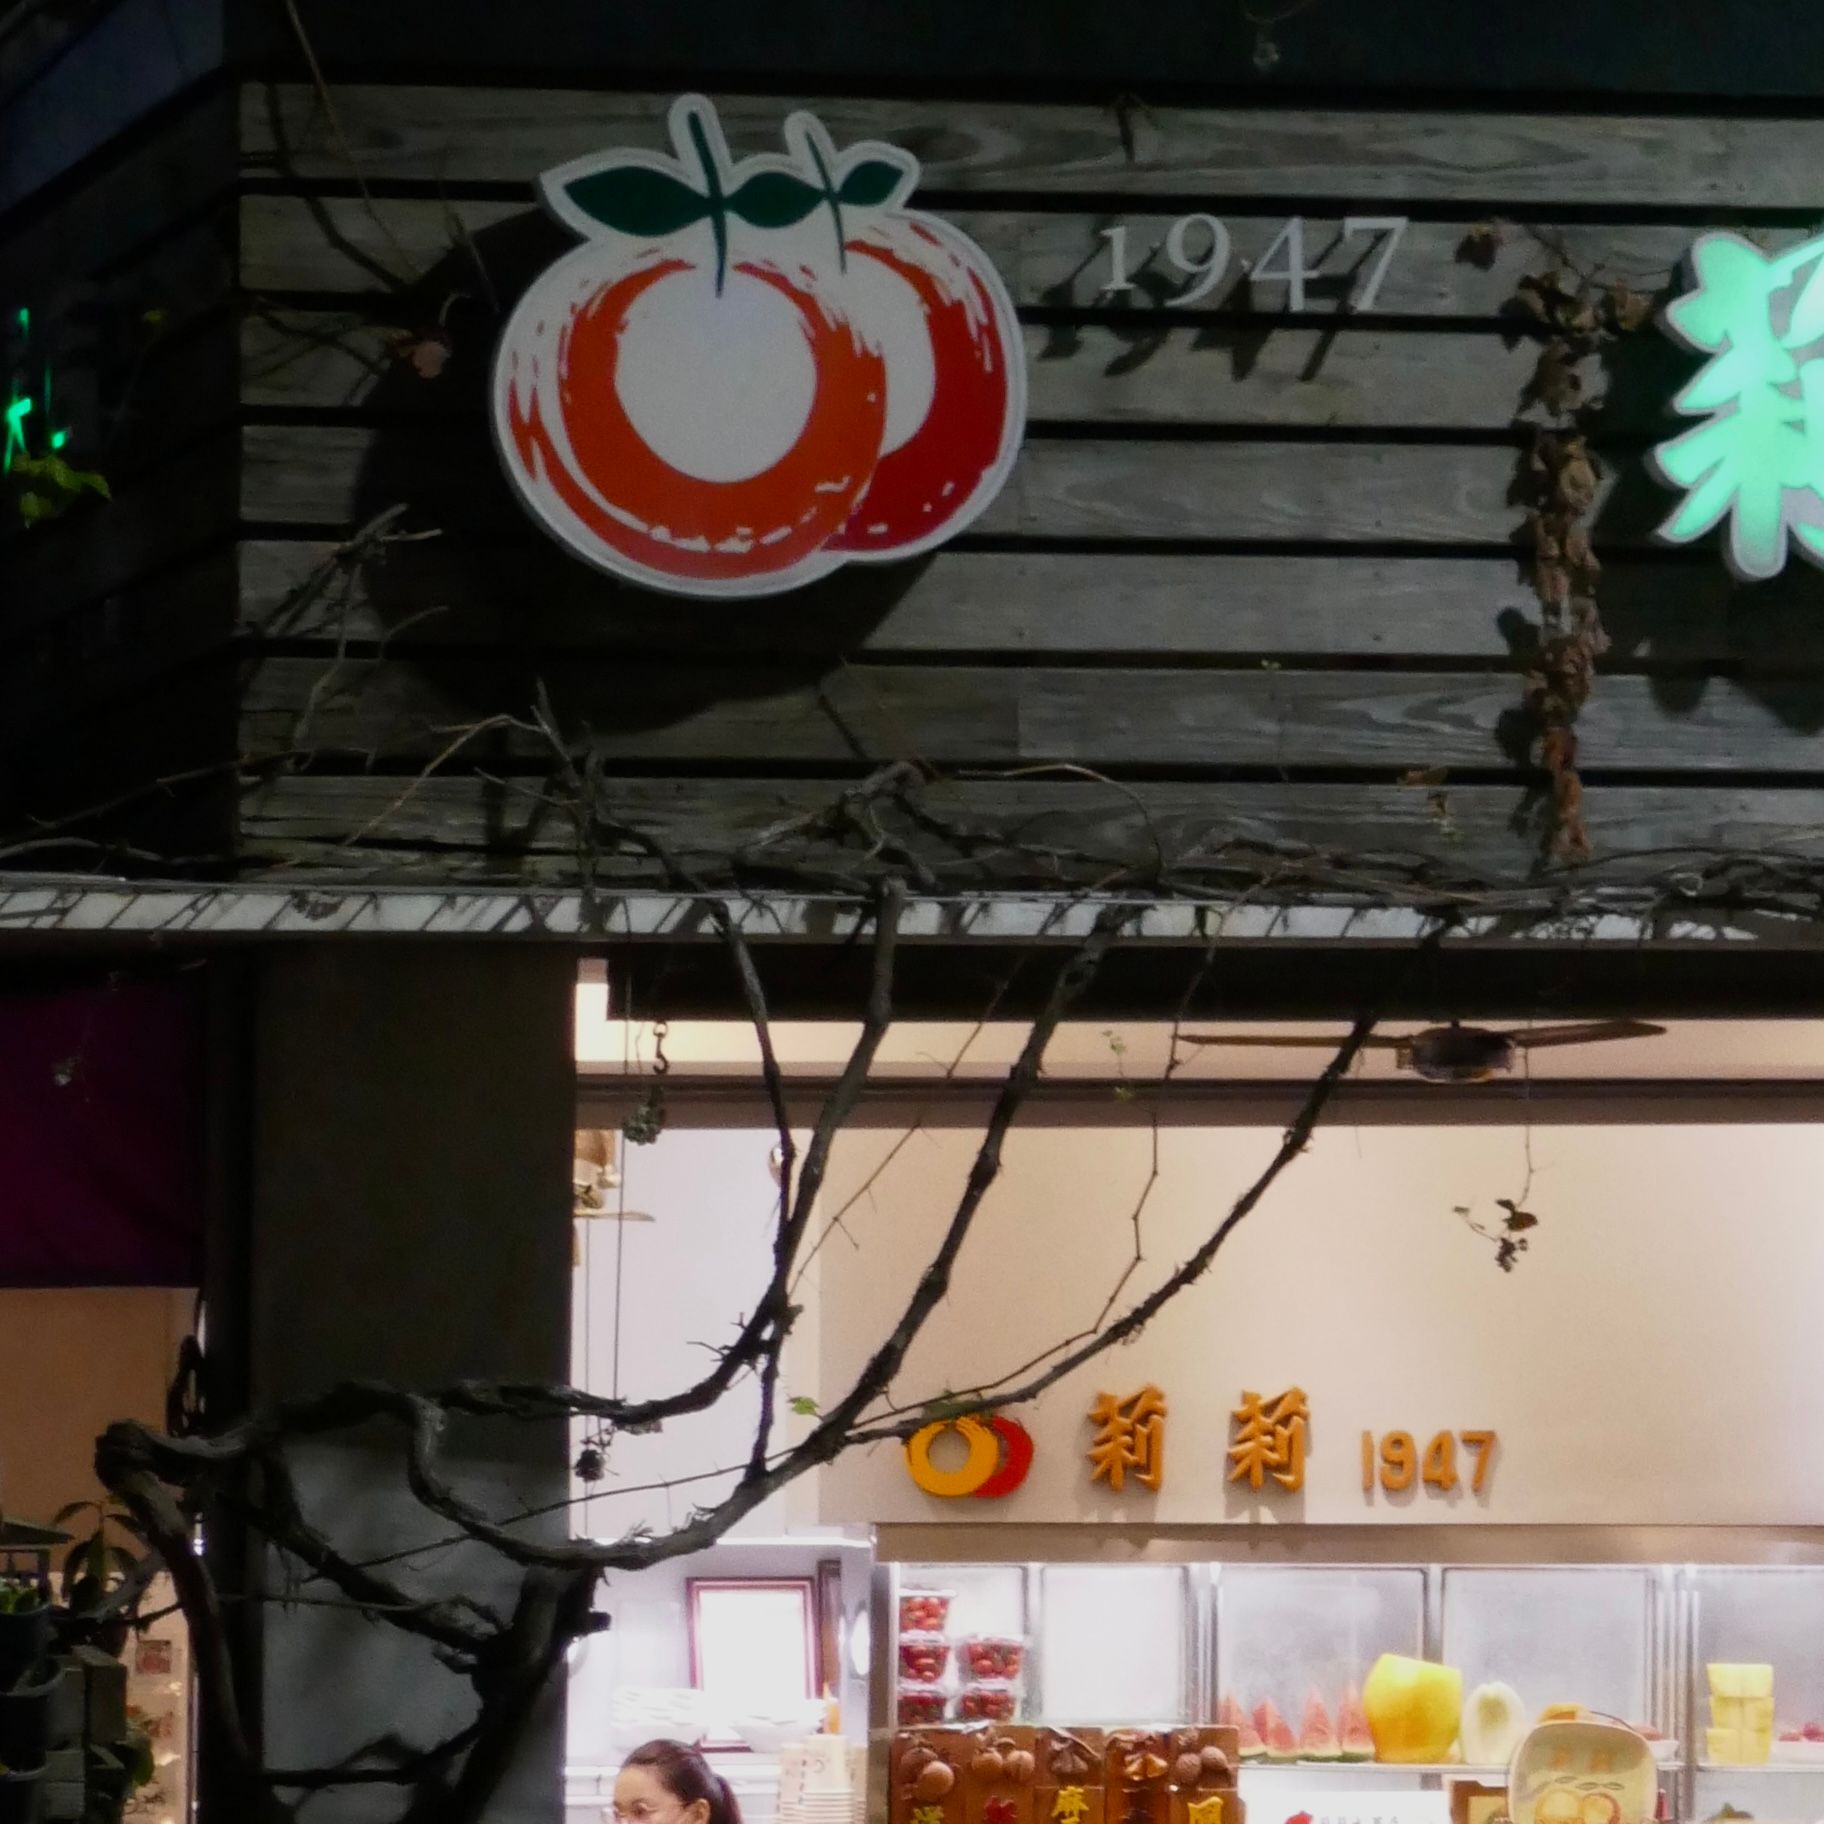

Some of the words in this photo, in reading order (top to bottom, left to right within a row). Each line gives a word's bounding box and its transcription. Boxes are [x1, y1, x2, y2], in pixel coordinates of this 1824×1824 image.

[1100, 212, 1409, 312] 1947
[1088, 1383, 1310, 1493] 莉莉
[1361, 1430, 1498, 1492] 1947
